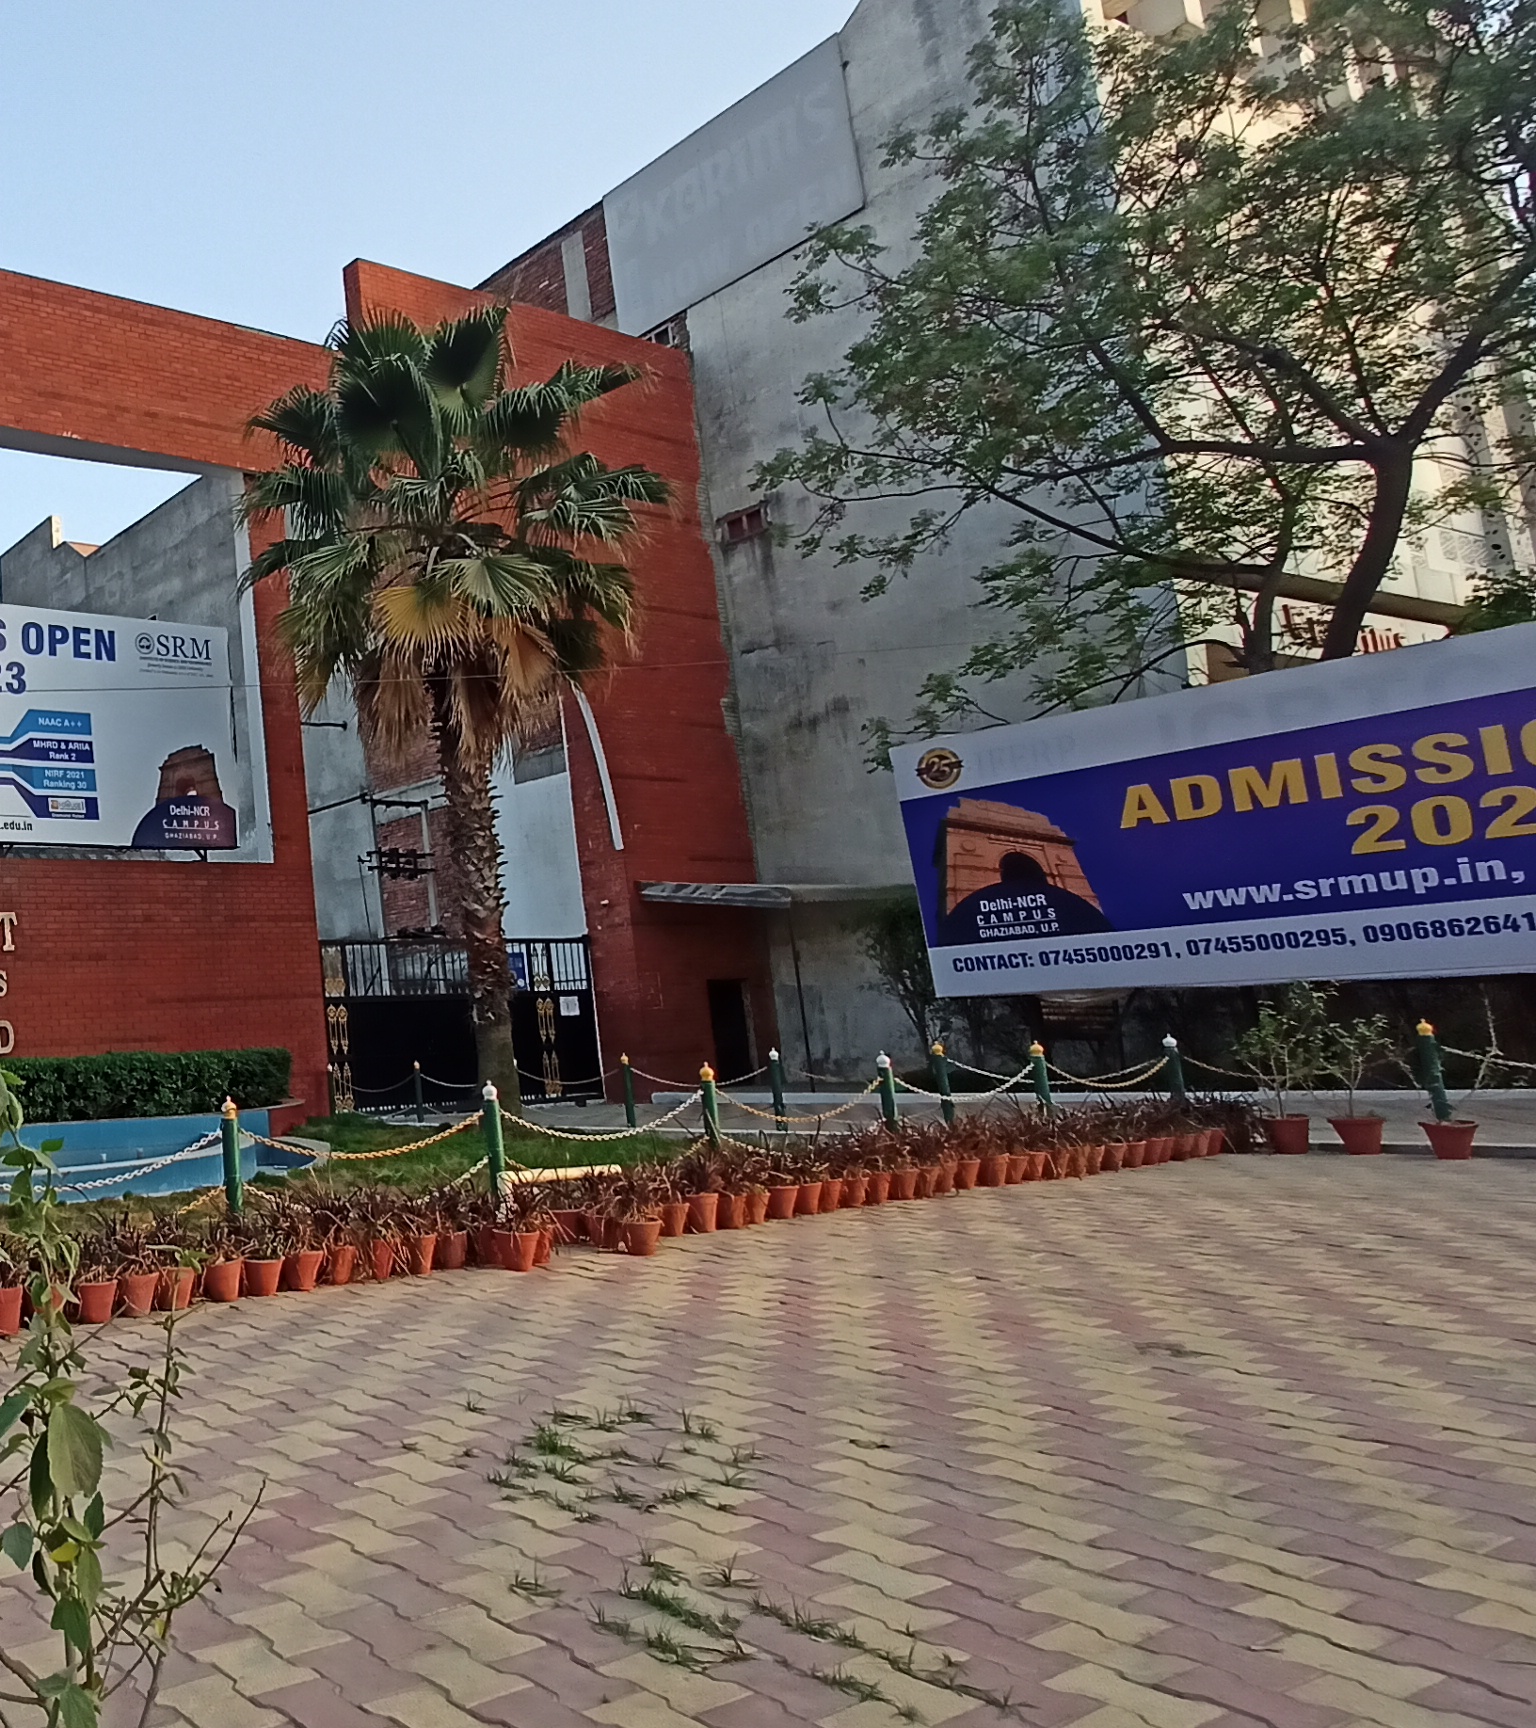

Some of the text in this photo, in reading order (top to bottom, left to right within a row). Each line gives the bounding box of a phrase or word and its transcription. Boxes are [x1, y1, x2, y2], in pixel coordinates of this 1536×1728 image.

[21, 621, 117, 662] OPEN
[156, 634, 212, 660] SRM
[38, 717, 62, 727] NAAC
[32, 740, 58, 750] MHRD
[48, 751, 77, 761] Rank 2
[928, 757, 952, 773] 25
[44, 769, 85, 779] NIRF 2021
[1120, 719, 1536, 829] ADMISSI
[43, 780, 87, 790] Ranking 30
[169, 804, 211, 817] Delhi-NCR
[162, 818, 220, 830] CAMPUS
[1345, 785, 1536, 855] 202
[1182, 857, 1526, 910] www.srmup.in,
[979, 893, 1048, 912] Delhi-NCR
[976, 907, 1057, 926] CAMPUS
[952, 911, 1536, 973] CONTACT: 07455000291, 07455000295, 0906862641
